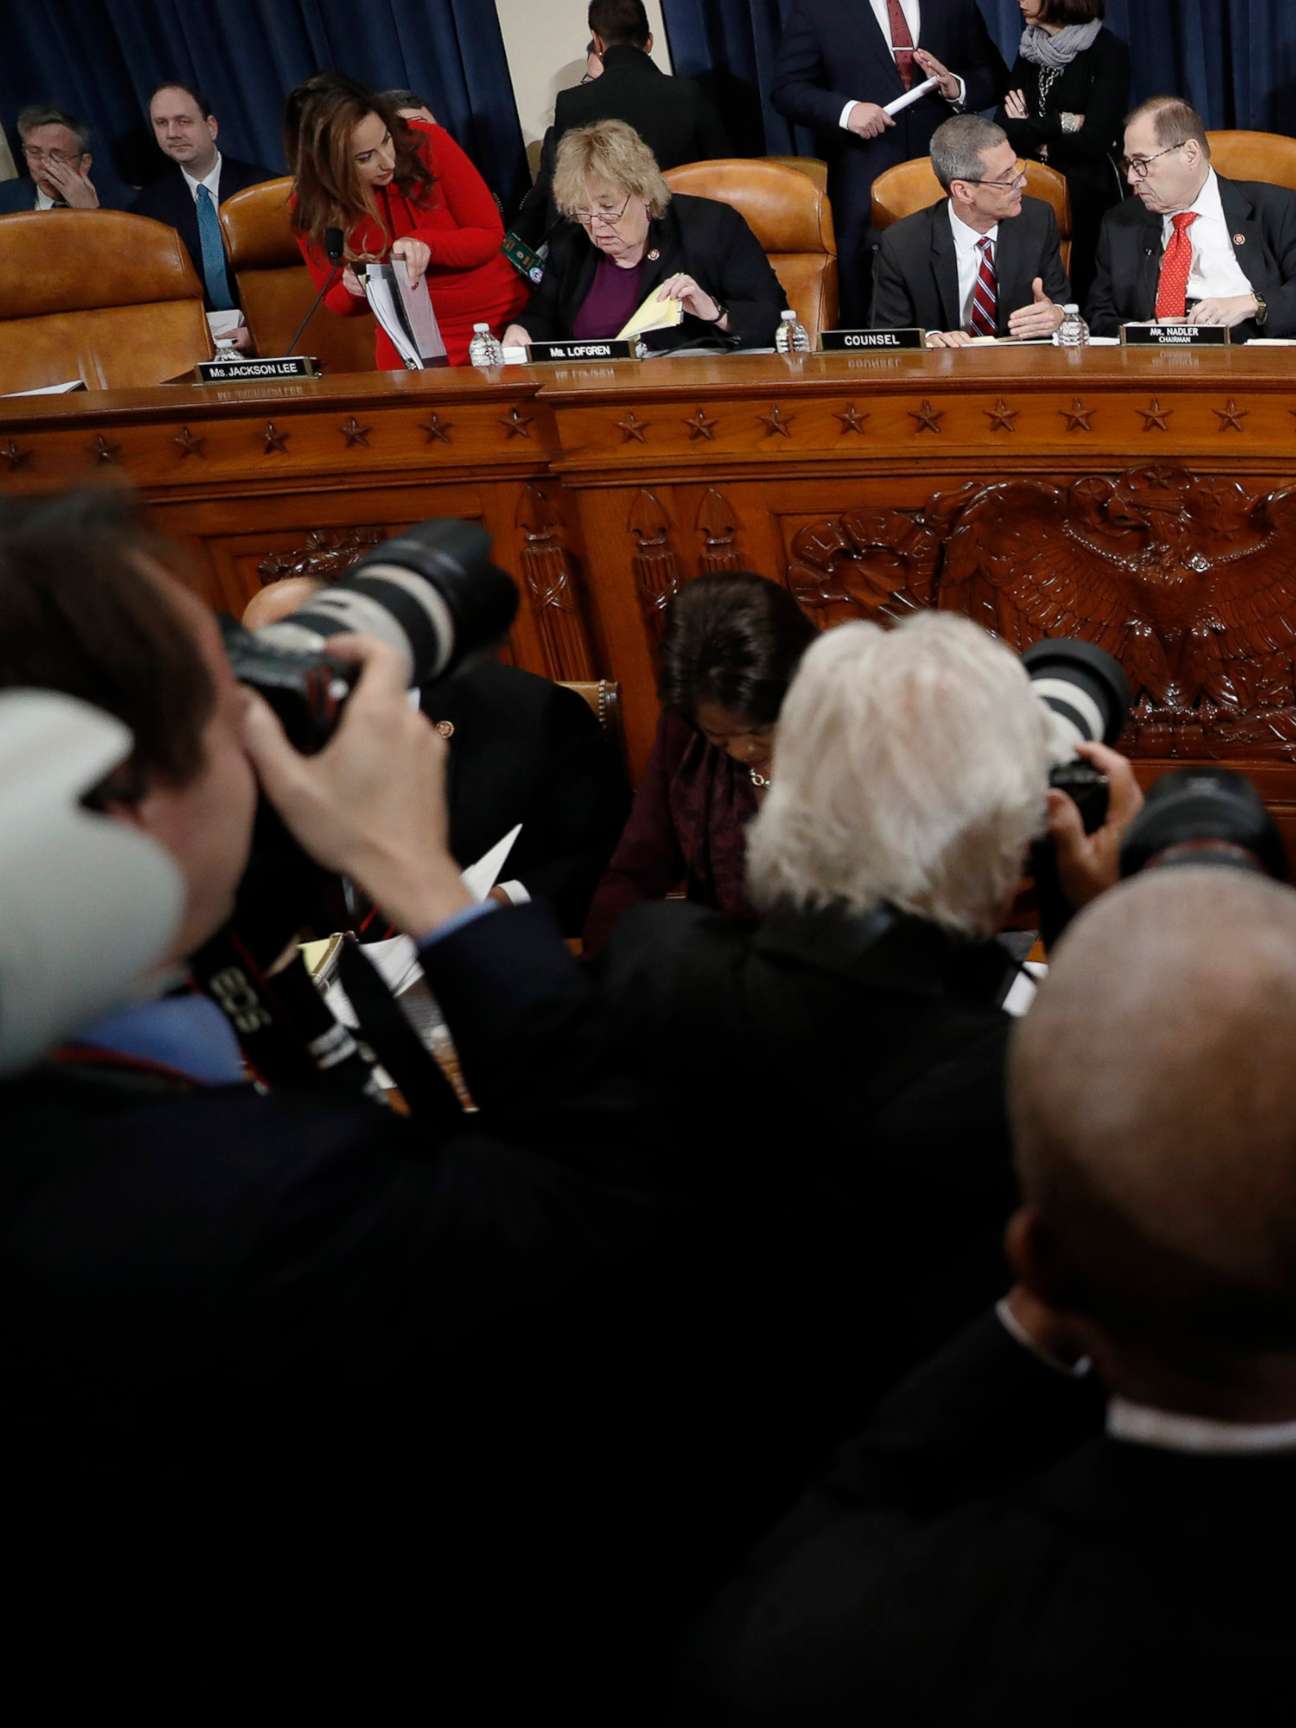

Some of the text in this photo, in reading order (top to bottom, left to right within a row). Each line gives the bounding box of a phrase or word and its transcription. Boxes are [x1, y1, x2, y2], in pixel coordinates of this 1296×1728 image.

[1166, 328, 1199, 336] NADLER
[844, 334, 900, 346] COUNSEL
[567, 345, 611, 357] LOFGREN
[228, 364, 277, 377] JACKSON
[277, 363, 298, 374] LEE
